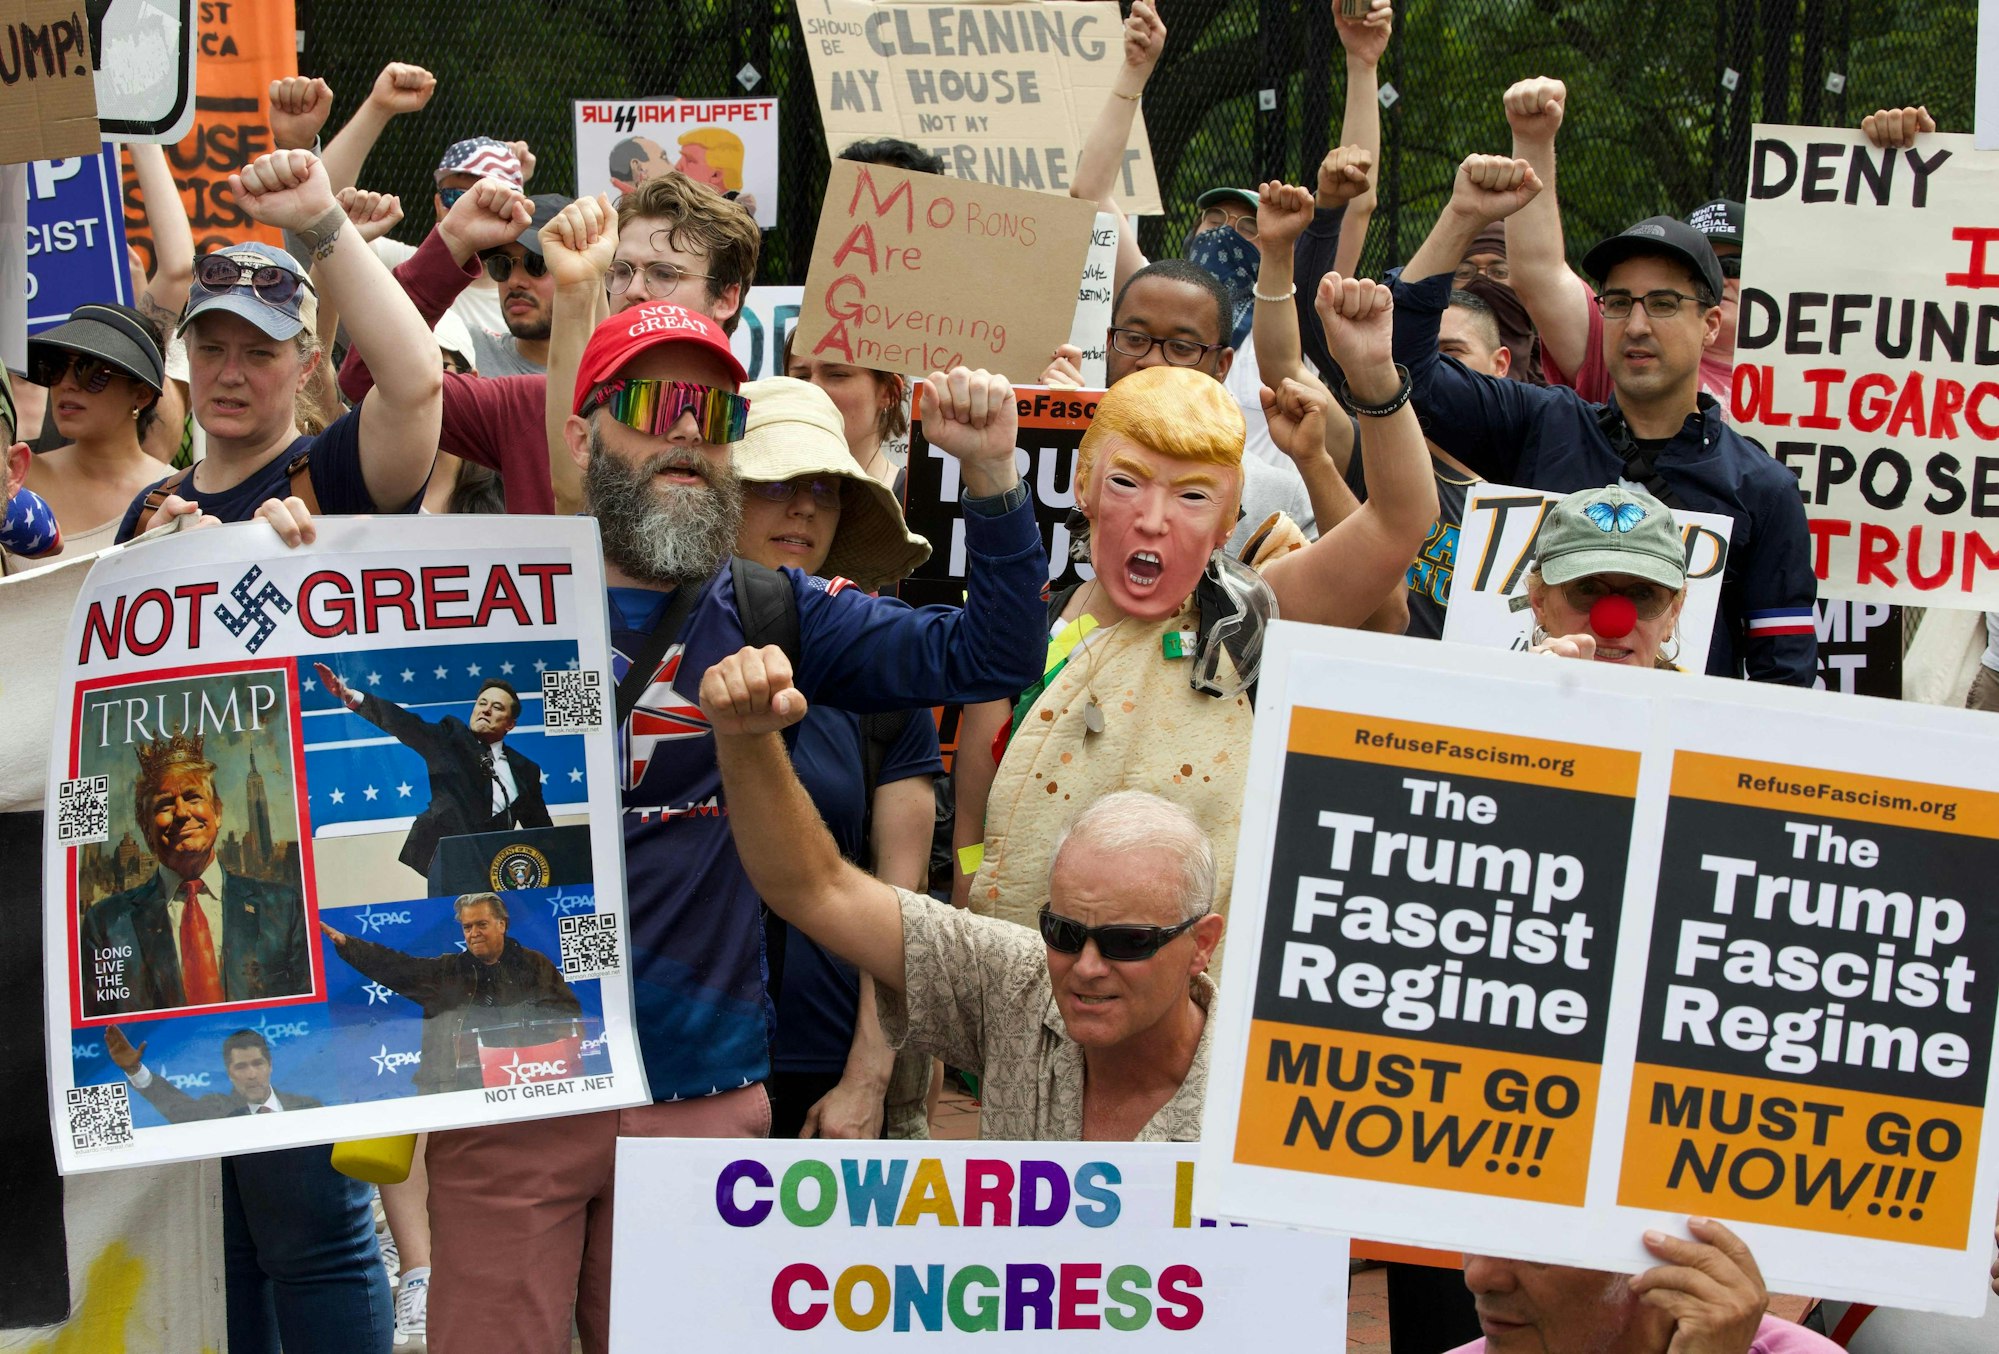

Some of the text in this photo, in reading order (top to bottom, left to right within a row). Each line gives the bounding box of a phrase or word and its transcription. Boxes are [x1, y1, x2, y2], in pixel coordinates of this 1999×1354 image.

[0, 11, 87, 86] UMP!
[197, 32, 239, 56] CA
[808, 7, 1106, 61] SHOULD CLEANING
[821, 39, 845, 56] BE
[680, 103, 773, 122] PUPPET
[830, 69, 1041, 113] MY HOUSE
[918, 114, 989, 133] NOT MY
[941, 143, 1141, 197] ERNMET
[1749, 136, 1953, 208] DENY
[1690, 212, 1713, 225] MEN
[1692, 203, 1726, 218] WHITE
[1698, 226, 1737, 234] STICE
[833, 222, 922, 275] Are
[628, 316, 708, 337] GREAT
[639, 305, 688, 319] NOT
[825, 274, 1006, 353] Governing
[1737, 287, 1999, 366] DEFUND
[1731, 362, 1999, 441] OLIGARC
[1743, 435, 1999, 518] EPOSE
[78, 563, 572, 665] NOT GREAT
[90, 684, 276, 749] TRUMP
[1354, 729, 1576, 778] RefuseFascism.org
[1402, 777, 1498, 825] The
[1737, 773, 1958, 821] RefuseFascism.org
[1318, 810, 1585, 914] Trump
[1784, 821, 1880, 868] The
[369, 911, 412, 929] CPAC
[1292, 876, 1595, 970] Fascist
[1700, 854, 1966, 957] Trump
[94, 945, 132, 961] LONG
[95, 960, 125, 975] LIVE
[1675, 919, 1976, 1014] Fascist
[96, 974, 123, 987] THE
[97, 987, 130, 1002] KING
[1278, 940, 1590, 1034] Regime
[263, 1021, 310, 1039] CPAC
[1662, 984, 1970, 1079] Regime
[484, 1076, 614, 1104] NOT GREAT .NET
[517, 1059, 567, 1079] CPAC
[1265, 1038, 1581, 1120] MUST GO
[1284, 1097, 1555, 1179] NOW!!!
[1648, 1082, 1962, 1164] MUST GO
[716, 1158, 1122, 1229] COWARDS
[1667, 1138, 1937, 1222] NOW!!!
[771, 1262, 1205, 1332] CONGRESS
